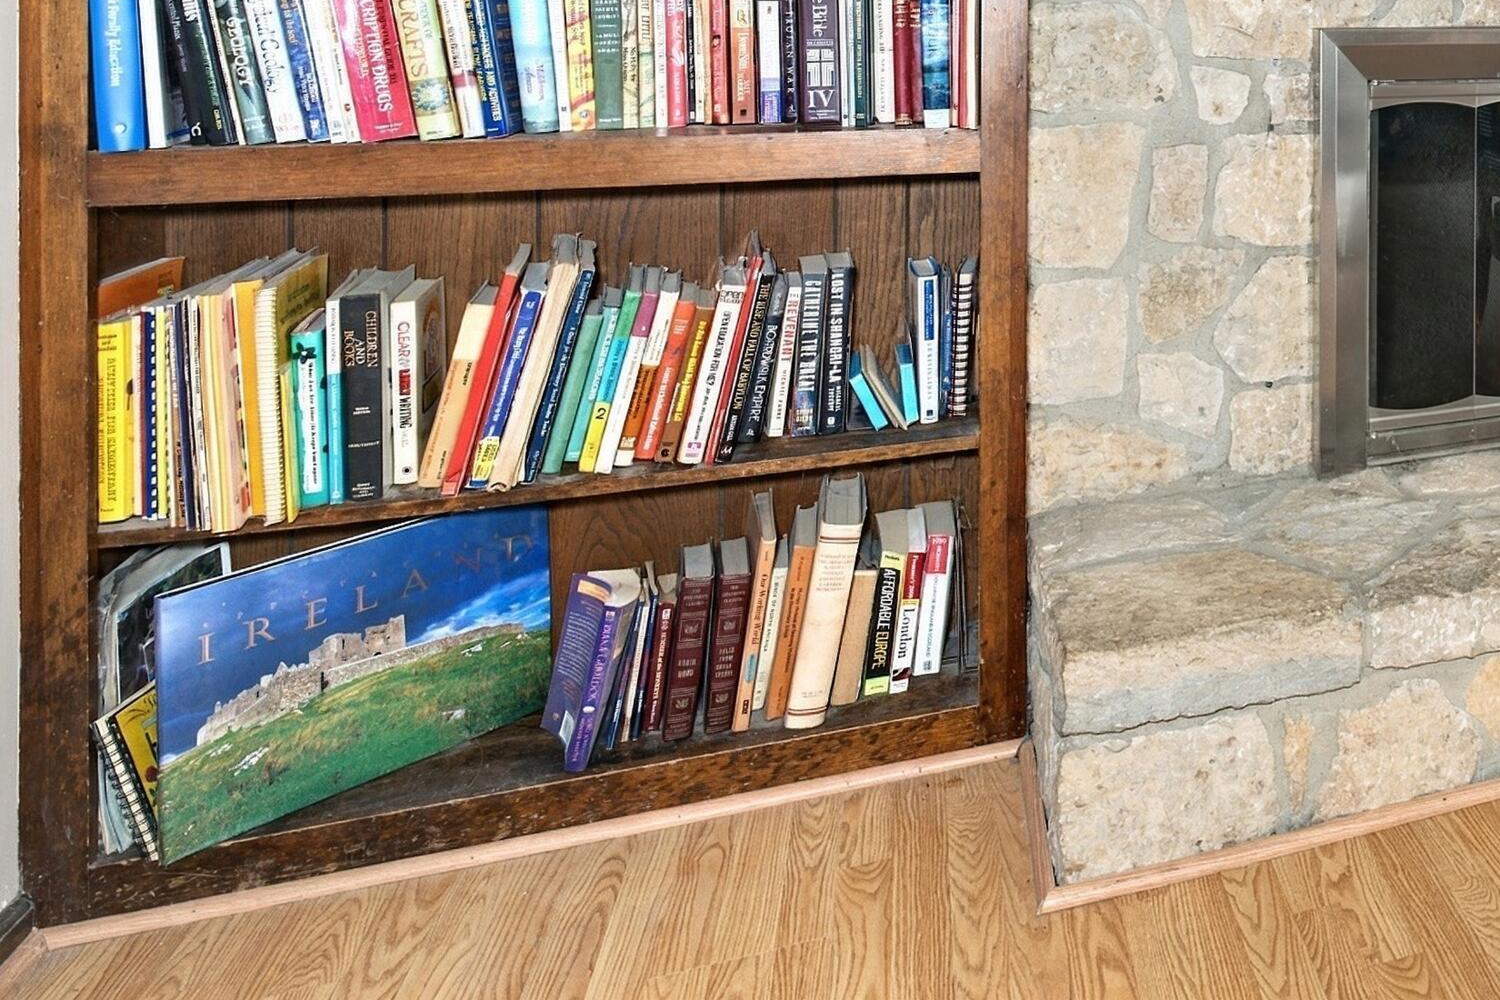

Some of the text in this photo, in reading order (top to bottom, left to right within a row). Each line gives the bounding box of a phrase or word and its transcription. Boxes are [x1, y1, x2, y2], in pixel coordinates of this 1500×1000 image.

[642, 15, 651, 41] LITTLE
[784, 11, 794, 58] TROJAN
[811, 5, 827, 39] Bible
[225, 16, 252, 87] GEOLOGY
[260, 39, 285, 93] Geology
[372, 65, 393, 112] DRUGS
[485, 71, 495, 86] AND
[786, 66, 795, 94] WAR
[808, 90, 833, 108] IV
[754, 301, 764, 319] RISE
[759, 284, 770, 300] THE
[365, 311, 378, 368] CHILDREN
[708, 311, 731, 371] OPEN EDUCATION FOR
[749, 320, 760, 338] AND
[781, 300, 799, 362] REVENANT
[797, 280, 821, 392] CATHERINE THE GREAT
[828, 273, 844, 383] LOST IN SHANGRI-LA
[343, 330, 355, 367] BOOKS
[355, 338, 365, 364] AND
[741, 359, 751, 372] OF
[743, 339, 757, 359] FALL
[397, 322, 412, 429] CLEAR WRITING
[732, 372, 748, 410] BABYLON
[749, 325, 778, 422] BOARDWALK EMPIRE
[596, 408, 607, 420] 2
[775, 400, 783, 420] PUNKE
[106, 358, 117, 502] ACTIVITIES FOR ELEMENTARY
[644, 421, 657, 450] Education
[198, 535, 534, 665] IRELAND
[751, 574, 769, 646] Our Working World
[872, 569, 896, 669] AFFORDABLE EUROPE
[658, 632, 667, 657] SUMMER
[897, 608, 915, 659] London
[588, 624, 612, 702] DIANA GABALDON
[653, 671, 662, 699] MONKEYS
